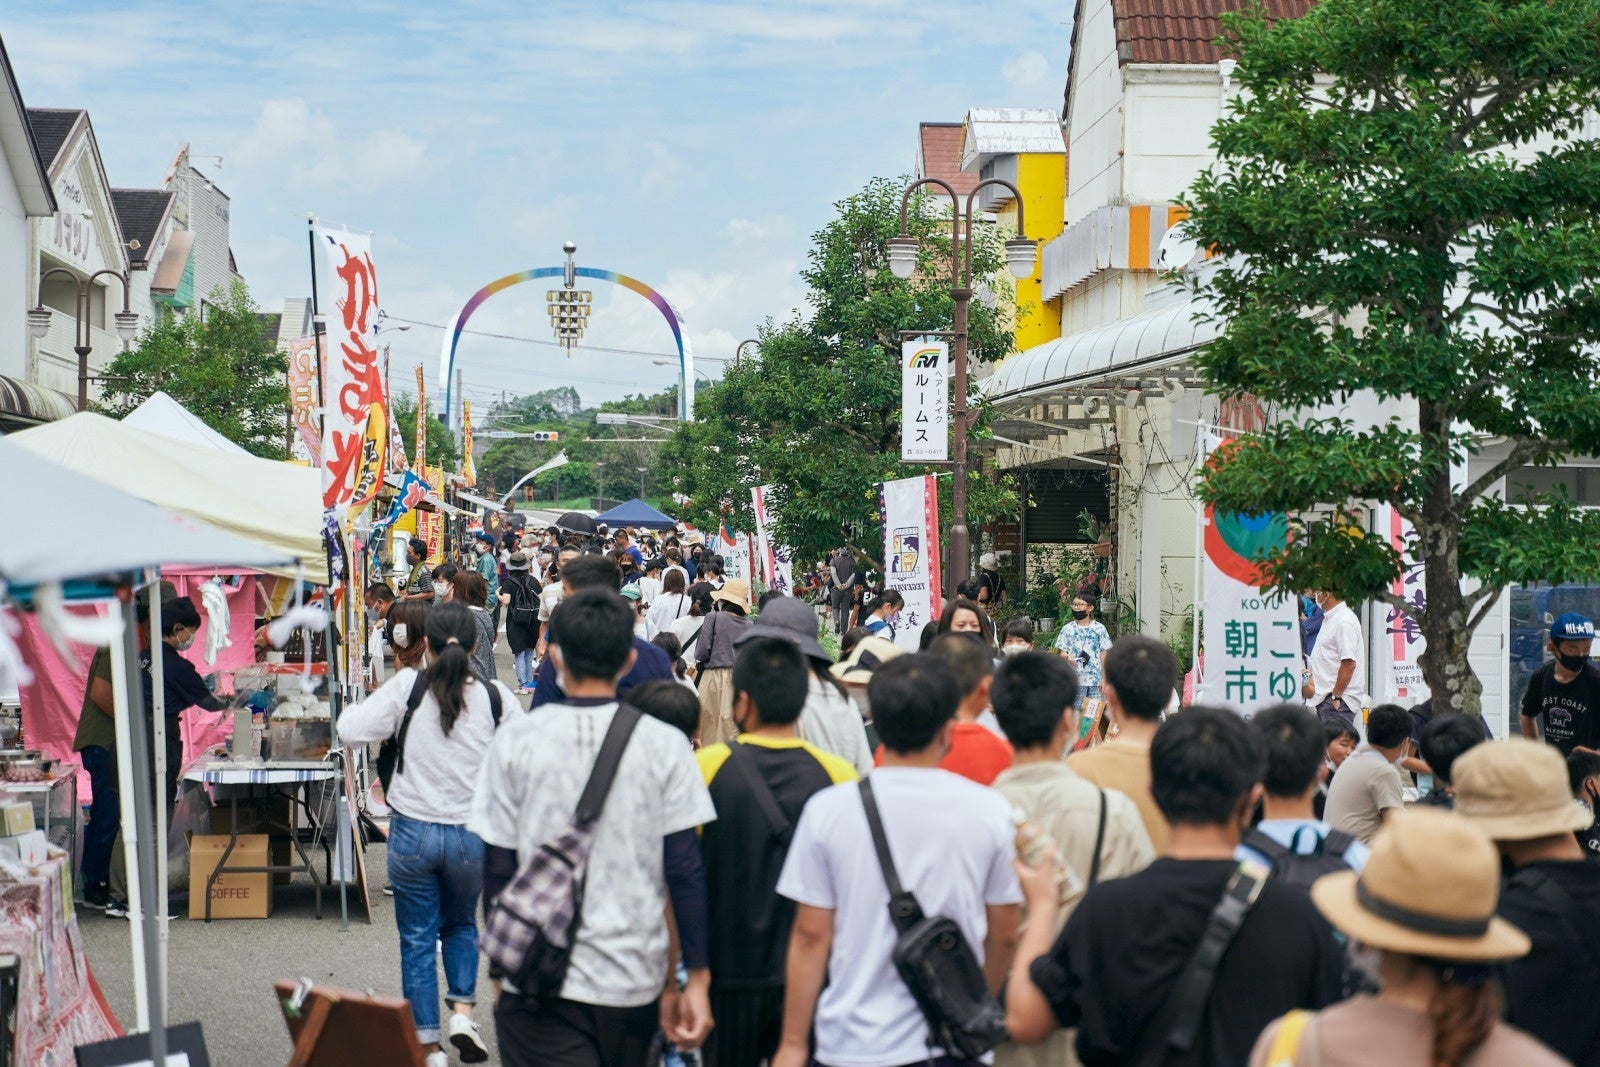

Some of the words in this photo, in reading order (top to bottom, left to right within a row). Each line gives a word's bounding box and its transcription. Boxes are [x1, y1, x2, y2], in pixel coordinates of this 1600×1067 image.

[915, 373, 929, 442] ルームス
[935, 370, 943, 424] ヘアーメイク
[1241, 598, 1280, 611] KOYU
[1224, 618, 1258, 704] 朝市
[1269, 620, 1297, 703] こゆ
[1561, 697, 1588, 713] COAST
[210, 887, 250, 899] COFFEE
